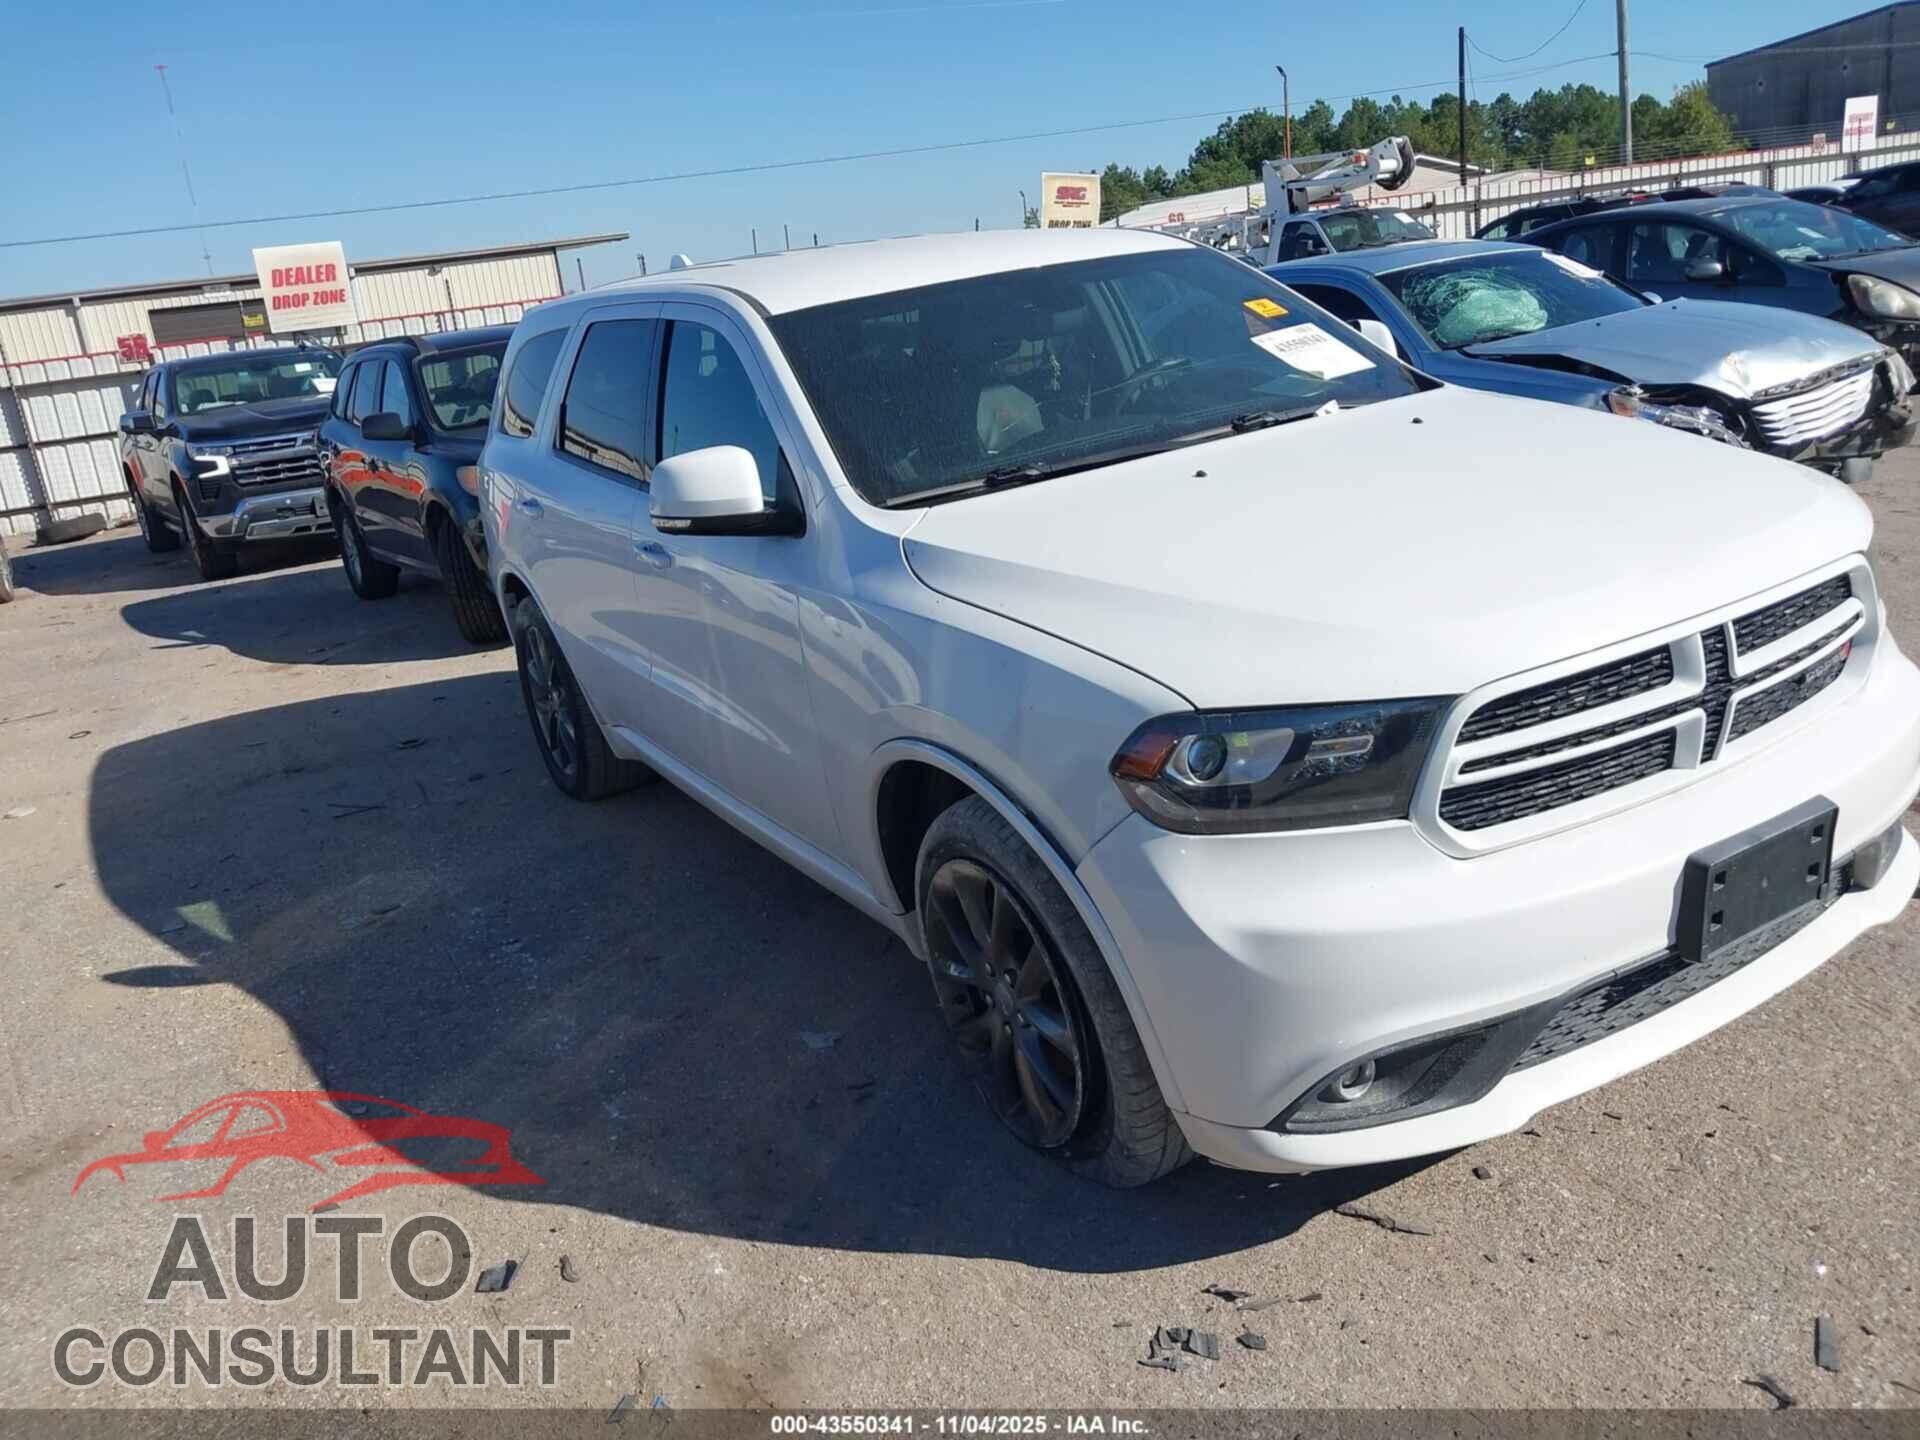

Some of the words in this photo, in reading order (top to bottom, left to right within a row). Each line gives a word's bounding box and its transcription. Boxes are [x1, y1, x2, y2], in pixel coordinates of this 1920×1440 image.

[1048, 219, 1071, 229] DROP
[271, 263, 337, 288] DEALER
[272, 292, 310, 311] DROP
[312, 288, 347, 306] ZONE
